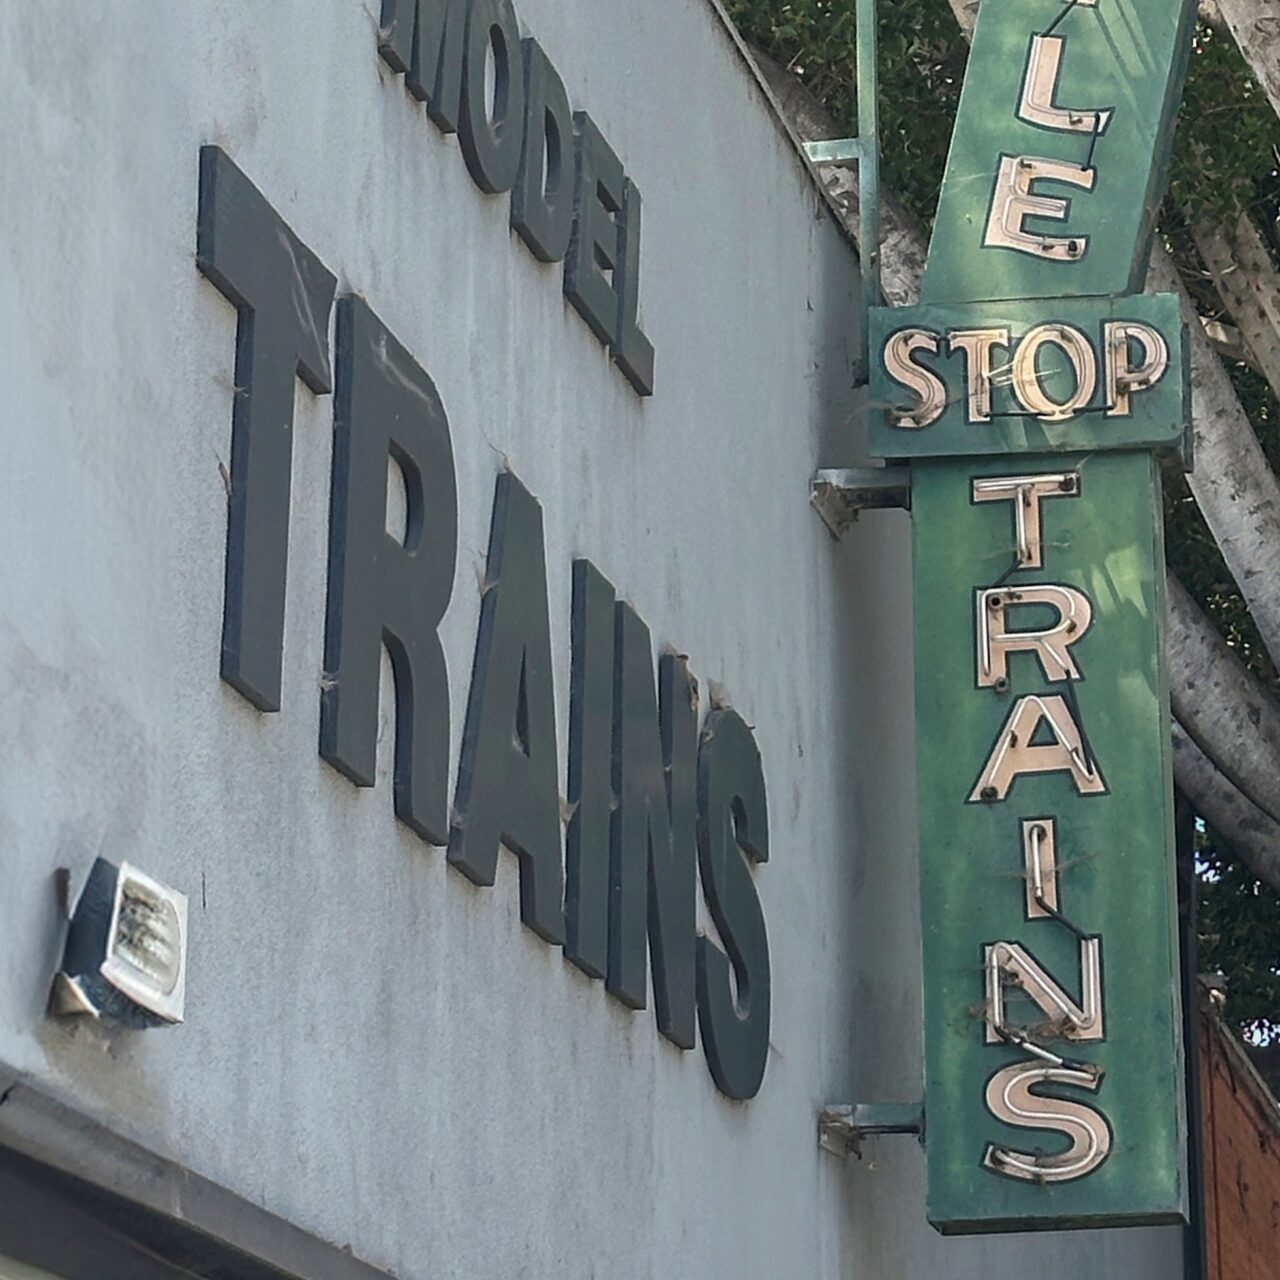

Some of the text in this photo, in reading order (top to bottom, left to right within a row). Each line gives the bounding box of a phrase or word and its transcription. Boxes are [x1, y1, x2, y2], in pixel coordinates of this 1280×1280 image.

[196, 145, 771, 1102] TRAINS
[880, 320, 1170, 430] STOP
[968, 473, 1114, 1183] TRAINS
